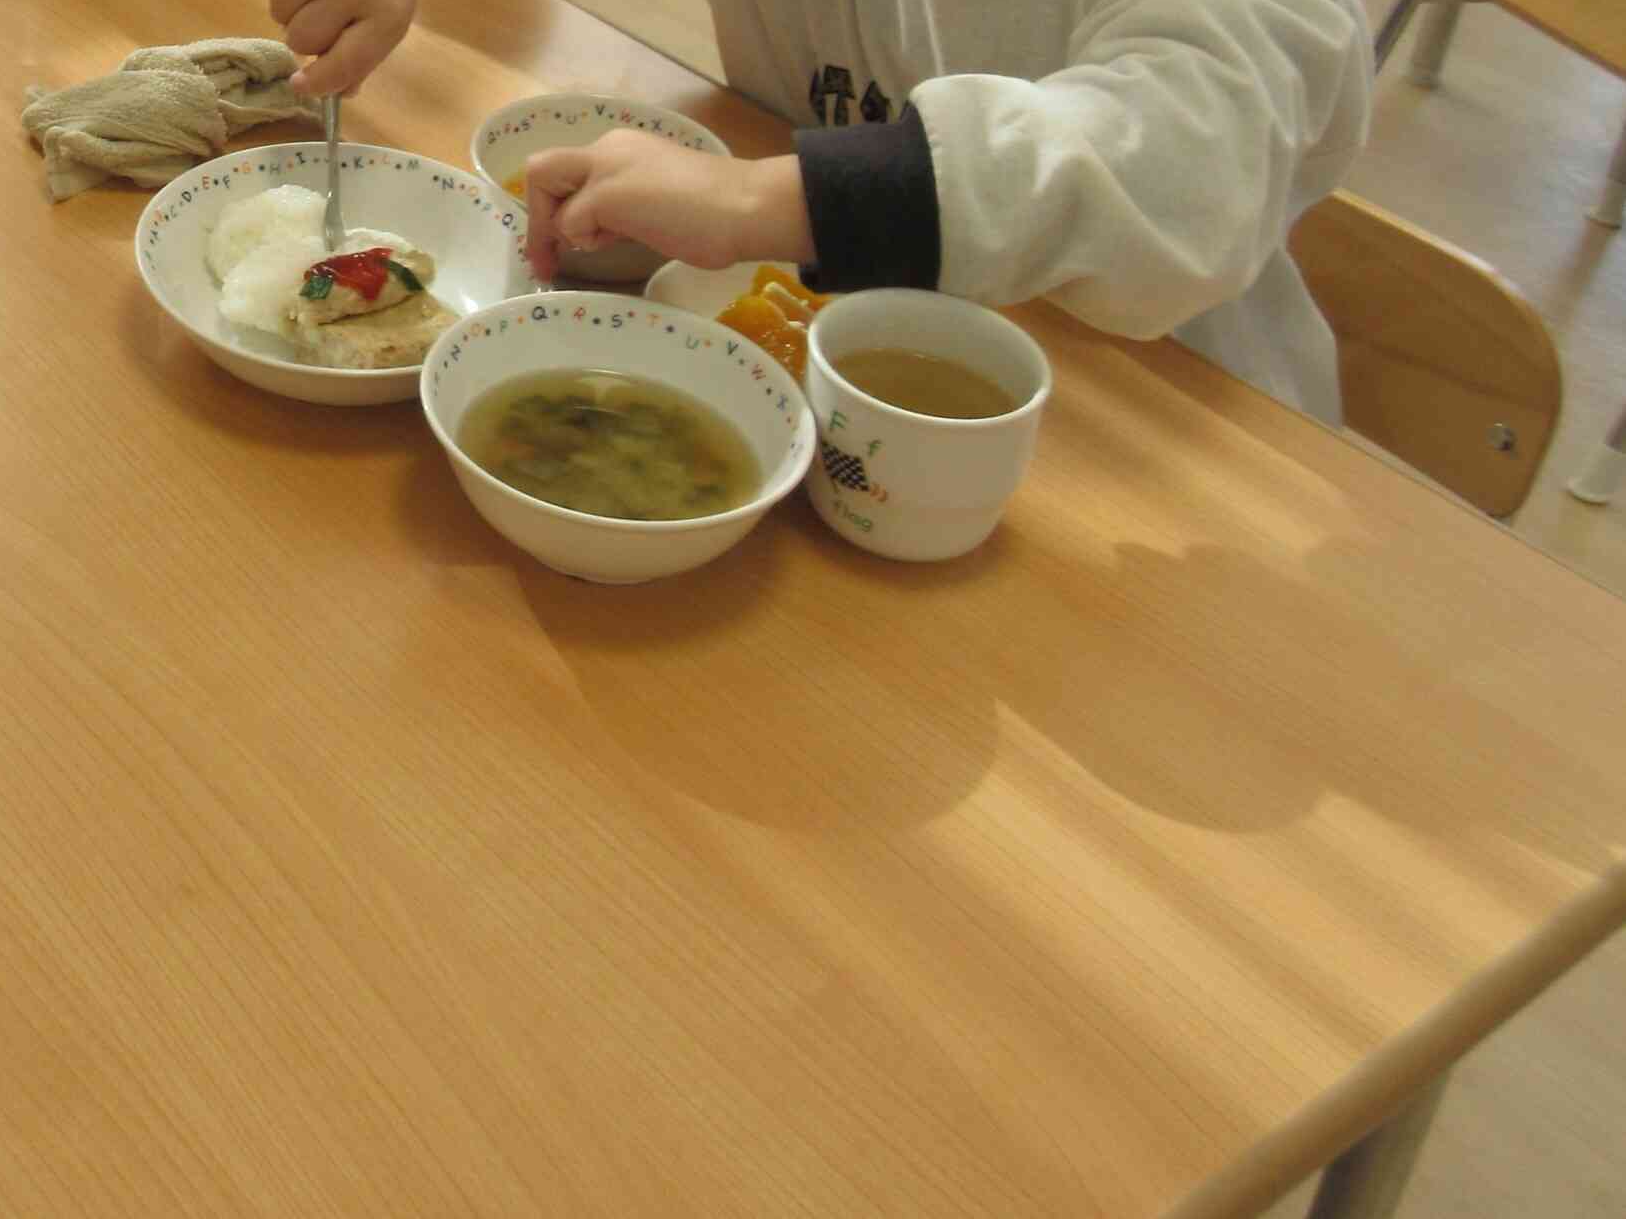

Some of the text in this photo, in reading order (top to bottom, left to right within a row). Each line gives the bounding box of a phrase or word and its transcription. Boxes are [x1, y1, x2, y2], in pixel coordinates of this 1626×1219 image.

[594, 103, 606, 117] V
[180, 190, 193, 203] D
[201, 173, 211, 191] E
[294, 151, 307, 166] I
[353, 155, 365, 170] K
[441, 177, 455, 191] N
[501, 212, 515, 229] Q
[531, 305, 549, 321] Q
[573, 306, 587, 322] R
[610, 313, 624, 329] S
[684, 333, 700, 351] U
[726, 339, 740, 356] V
[829, 410, 847, 432] F
